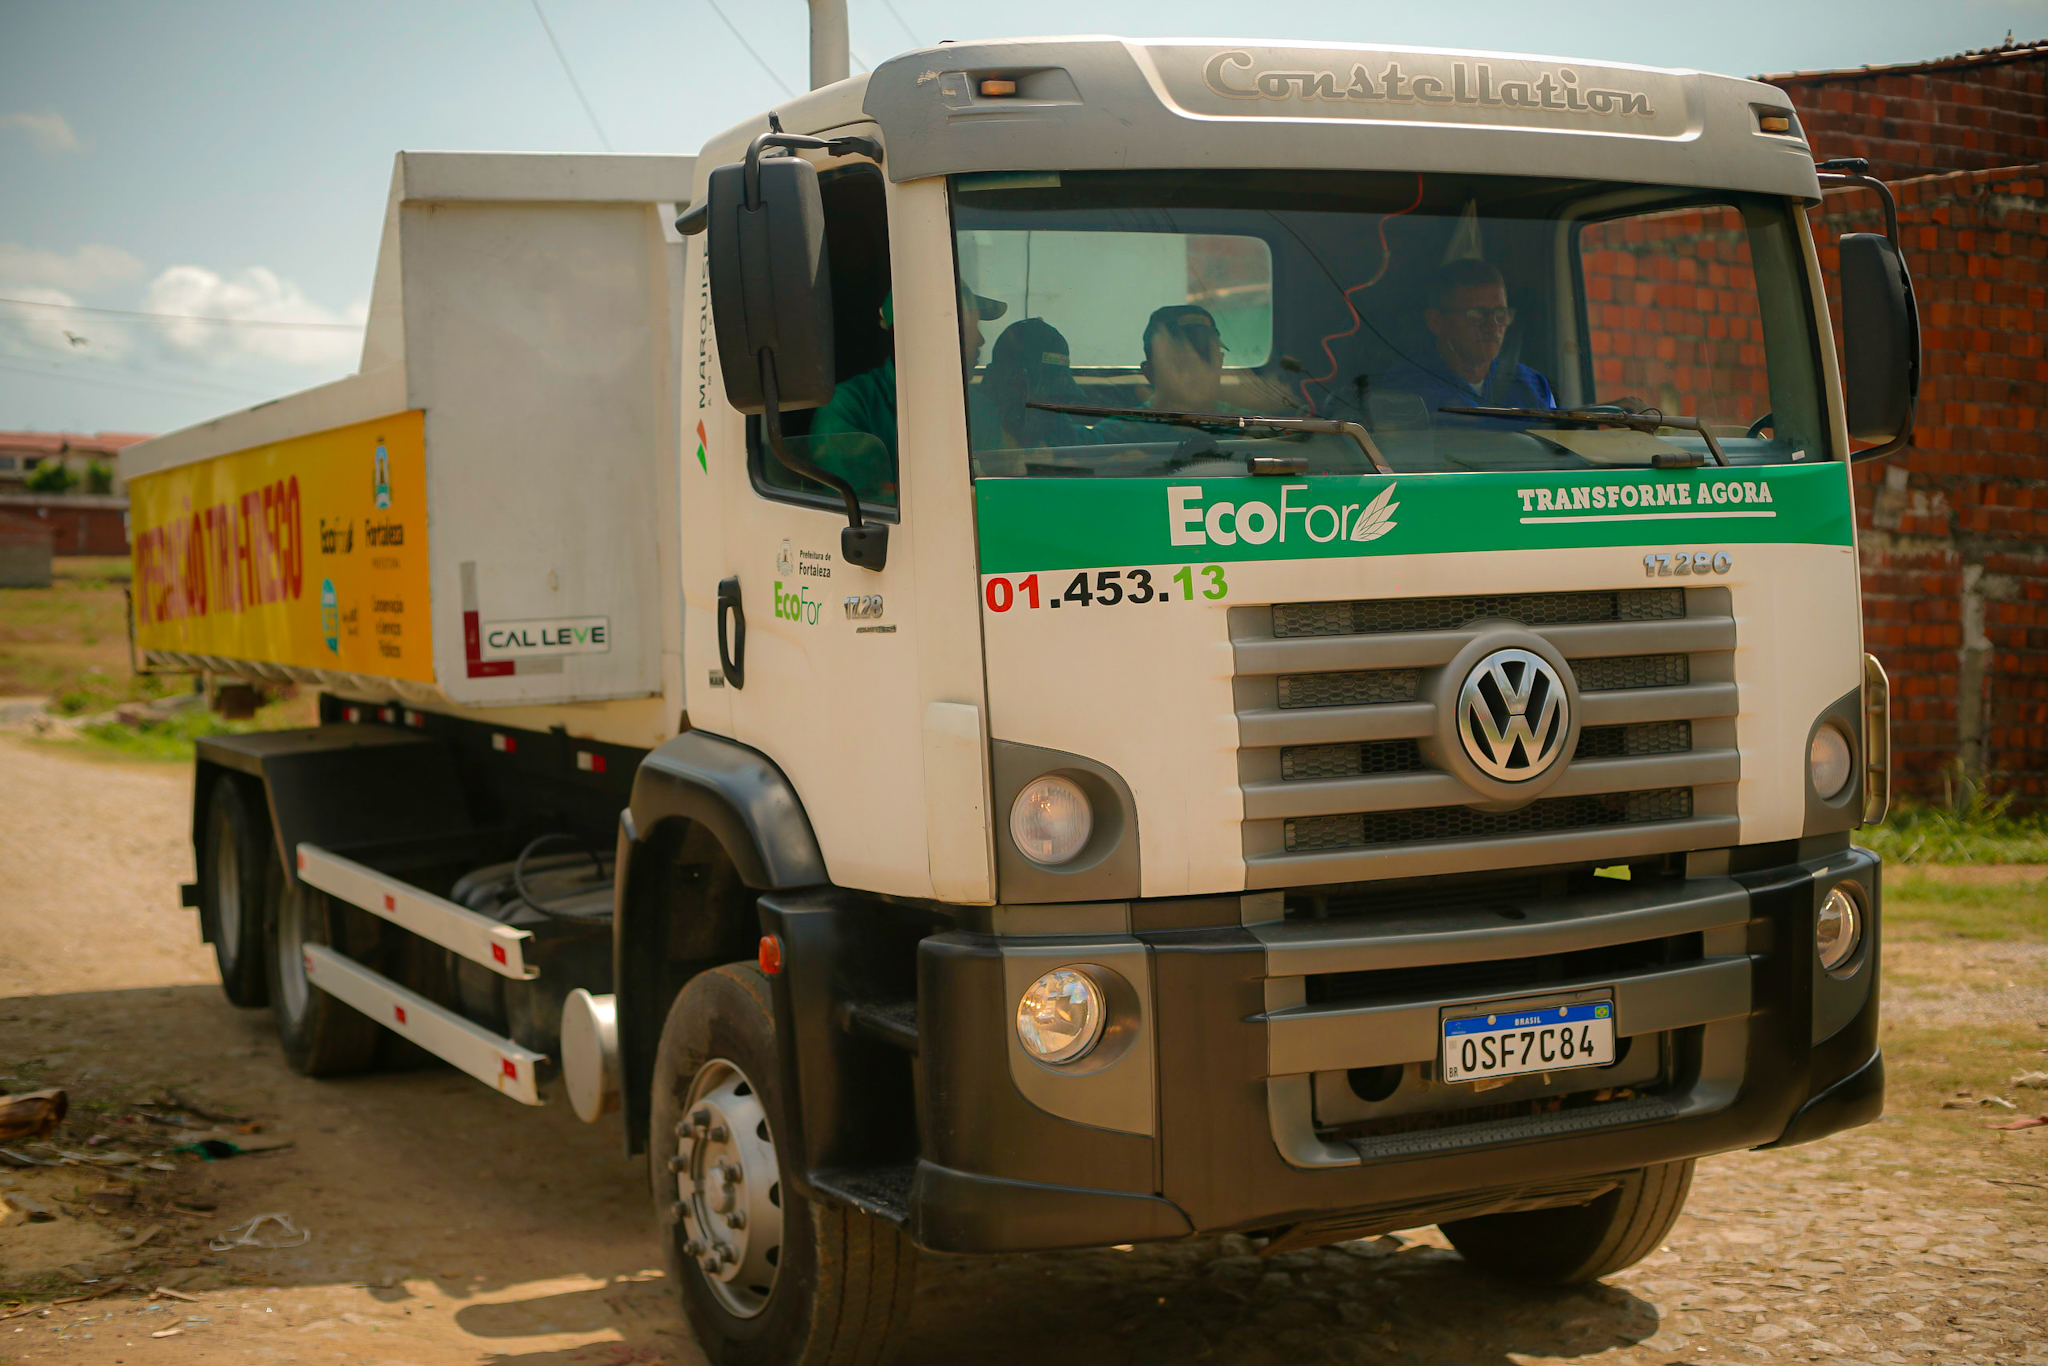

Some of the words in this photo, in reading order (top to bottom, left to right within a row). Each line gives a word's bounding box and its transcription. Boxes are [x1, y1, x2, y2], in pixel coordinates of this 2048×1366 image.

[1203, 51, 1655, 119] Constellation
[1517, 484, 1691, 511] TRANSFORME
[1697, 482, 1773, 504] AGORA
[1167, 485, 1359, 546] EcoFor
[799, 549, 824, 560] Prefeitura
[824, 552, 832, 561] de
[799, 561, 831, 578] Fortaleza
[774, 580, 822, 626] EcoFor
[985, 565, 1228, 613] 01.453.13
[1514, 1016, 1541, 1026] BRASIL
[1449, 1067, 1459, 1078] BR
